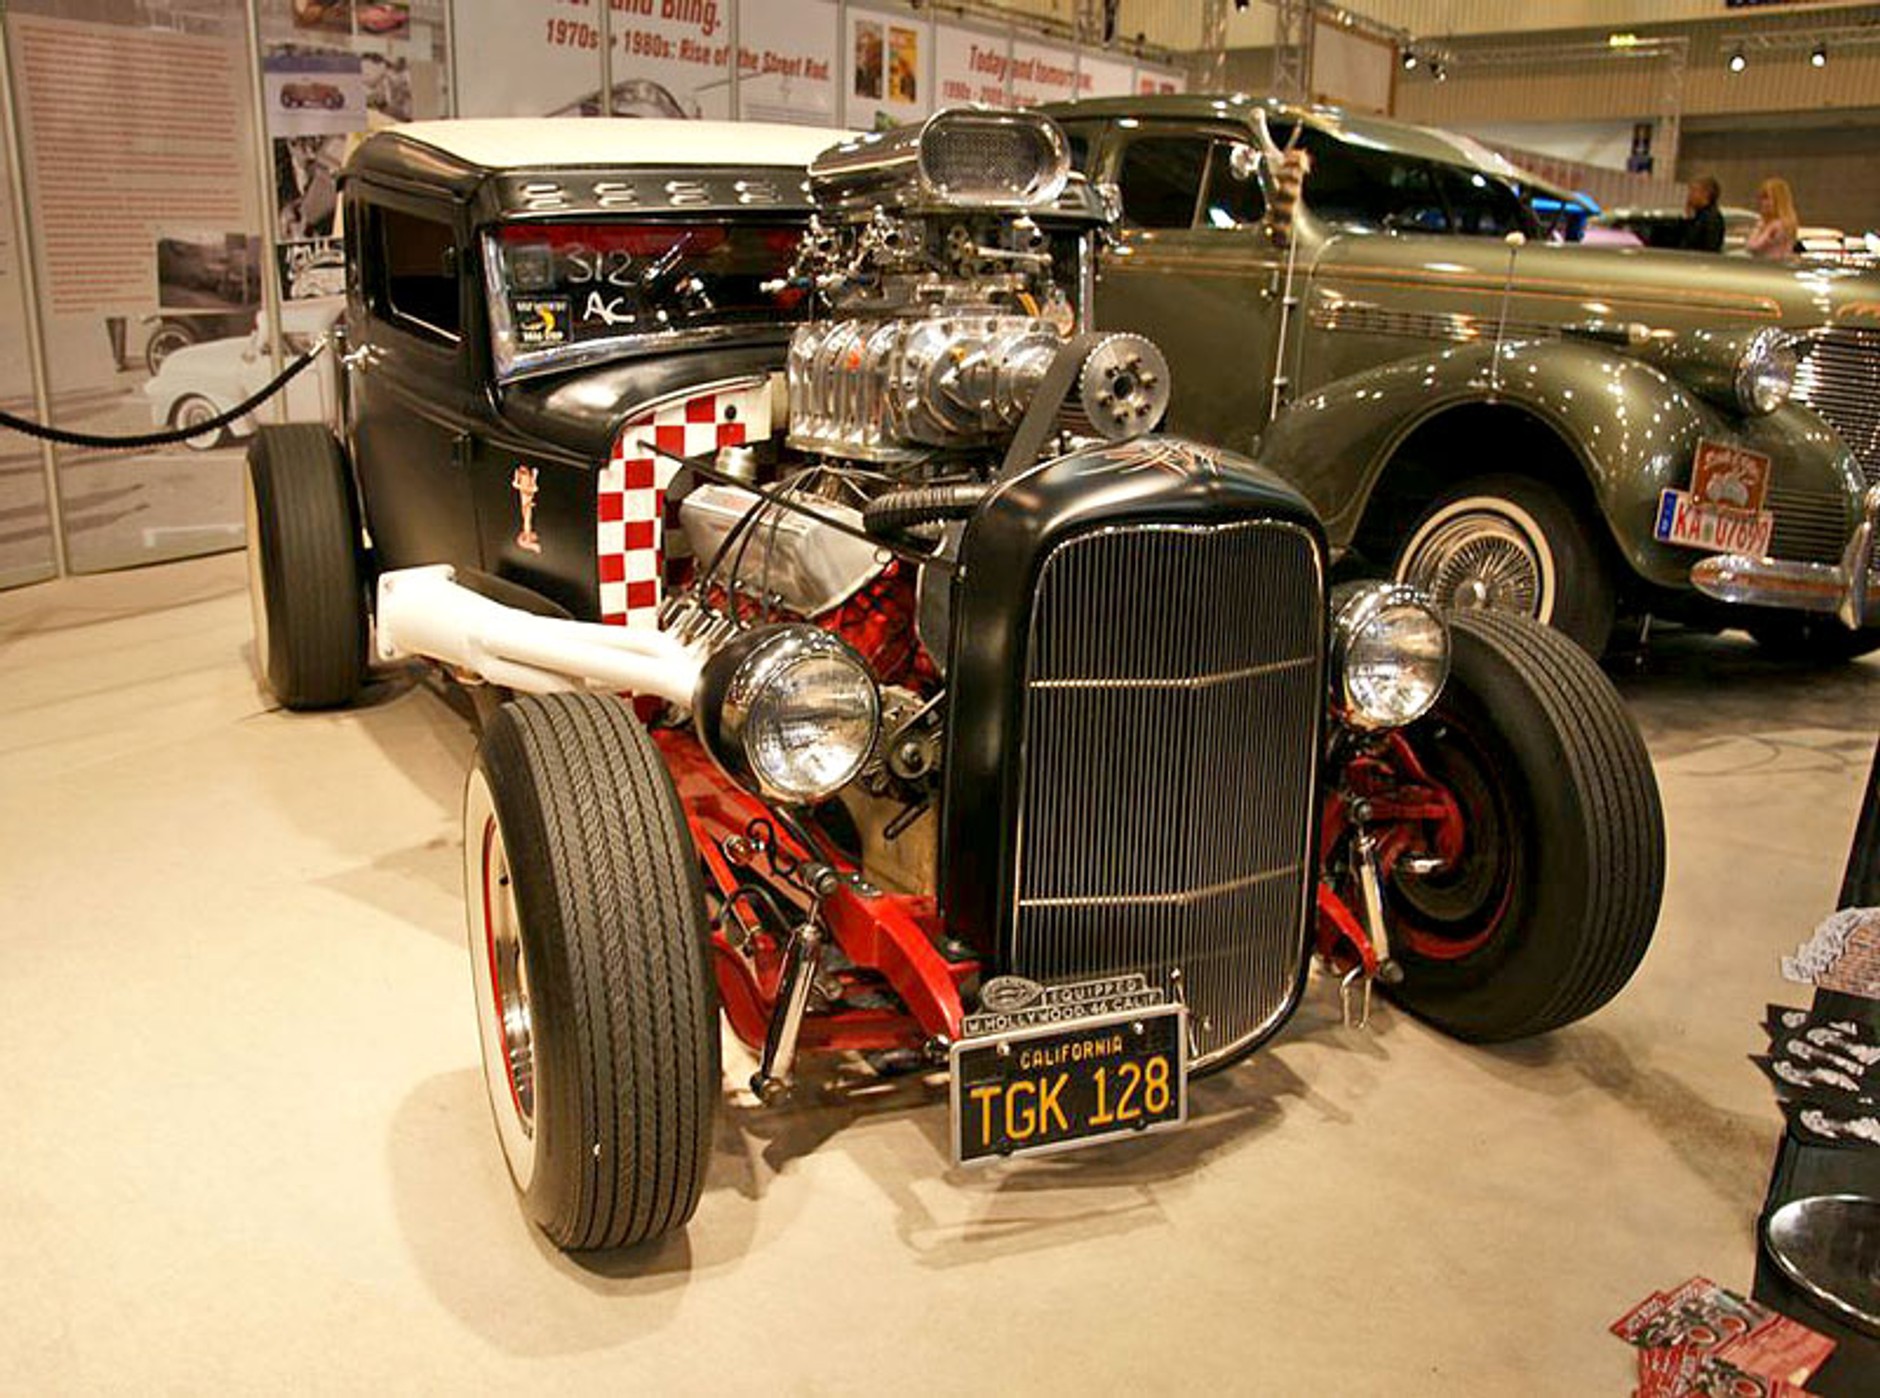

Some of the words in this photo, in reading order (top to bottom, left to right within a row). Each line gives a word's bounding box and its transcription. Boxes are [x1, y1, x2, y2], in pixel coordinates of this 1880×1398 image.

[661, 0, 721, 36] Bling.
[547, 19, 598, 49] 1970s
[624, 30, 676, 59] 1980s:
[678, 38, 710, 65] Rise
[714, 45, 730, 66] of
[763, 51, 801, 77] Street
[969, 44, 1007, 82] Today
[566, 242, 638, 287] 312
[583, 290, 636, 326] AC
[1020, 1035, 1123, 1070] CALIFORNIA
[970, 1073, 1069, 1146] TGK
[1088, 1055, 1170, 1126] 128
